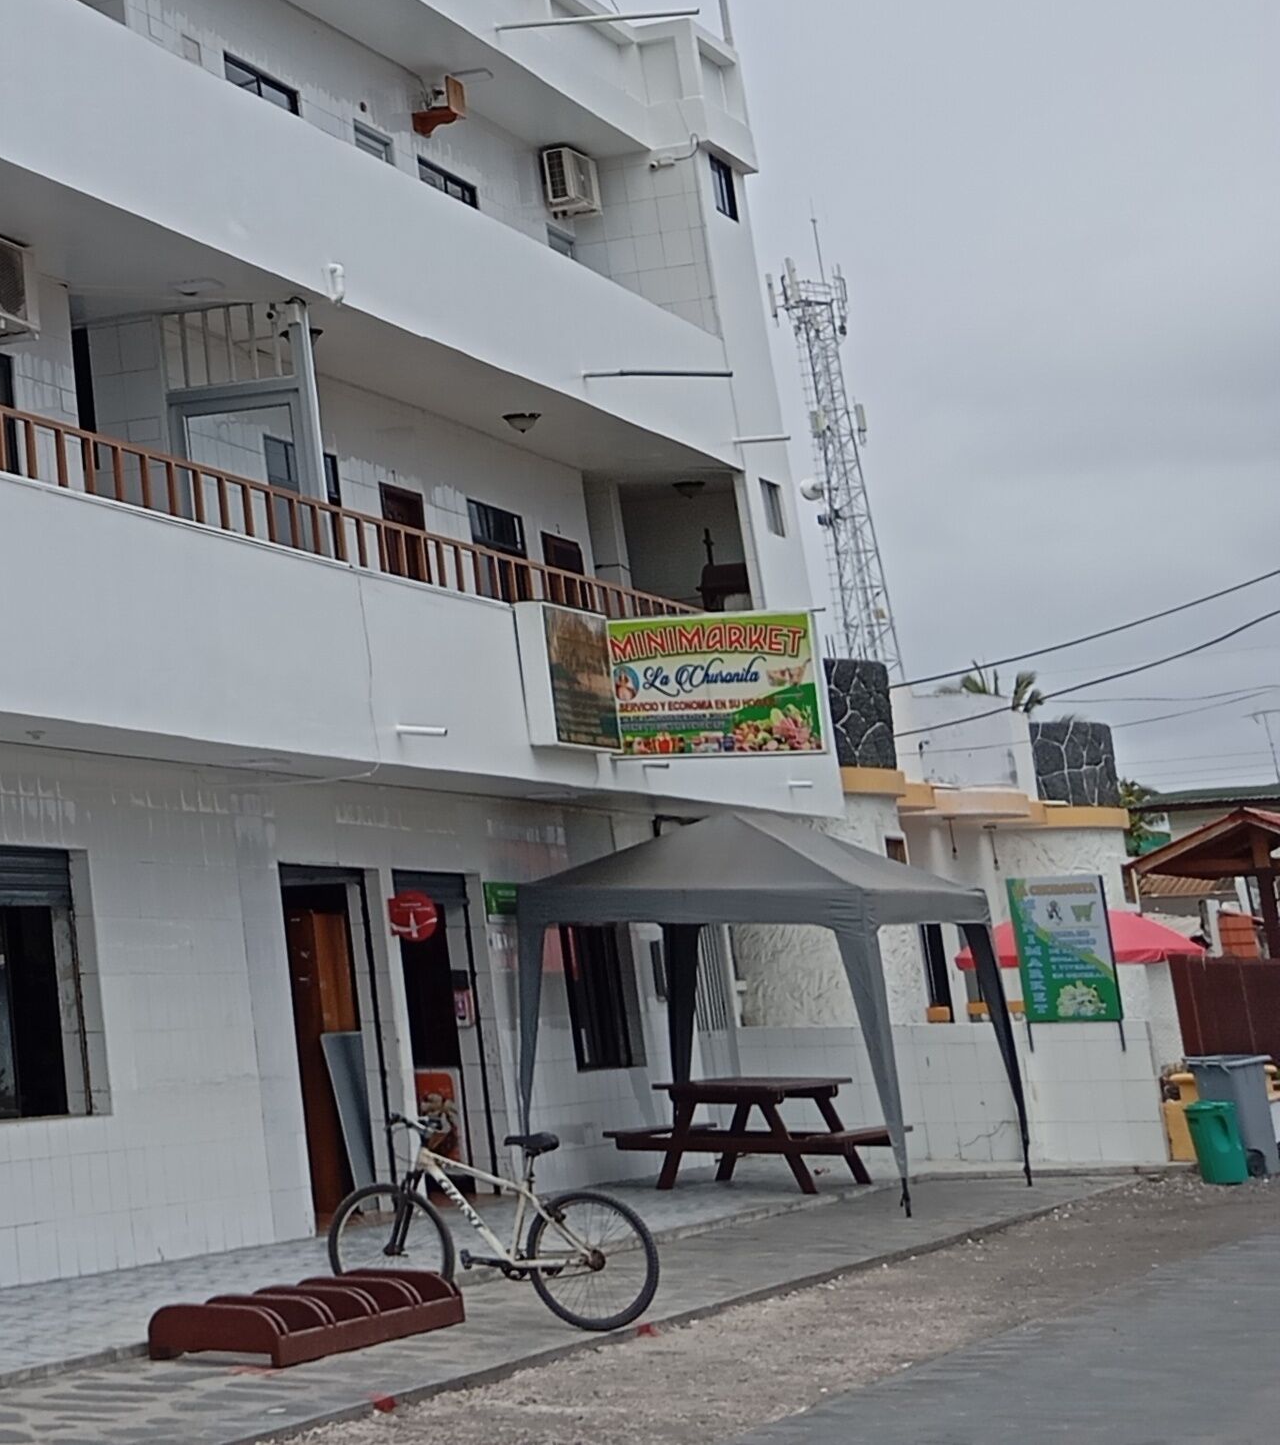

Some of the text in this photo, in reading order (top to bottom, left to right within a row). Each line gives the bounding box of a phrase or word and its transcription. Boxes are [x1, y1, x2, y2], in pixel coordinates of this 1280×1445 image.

[610, 623, 805, 665] MINIMARKET
[643, 665, 680, 696] La
[619, 702, 658, 713] SERVICIO
[659, 701, 666, 711] Y
[714, 699, 727, 710] EN
